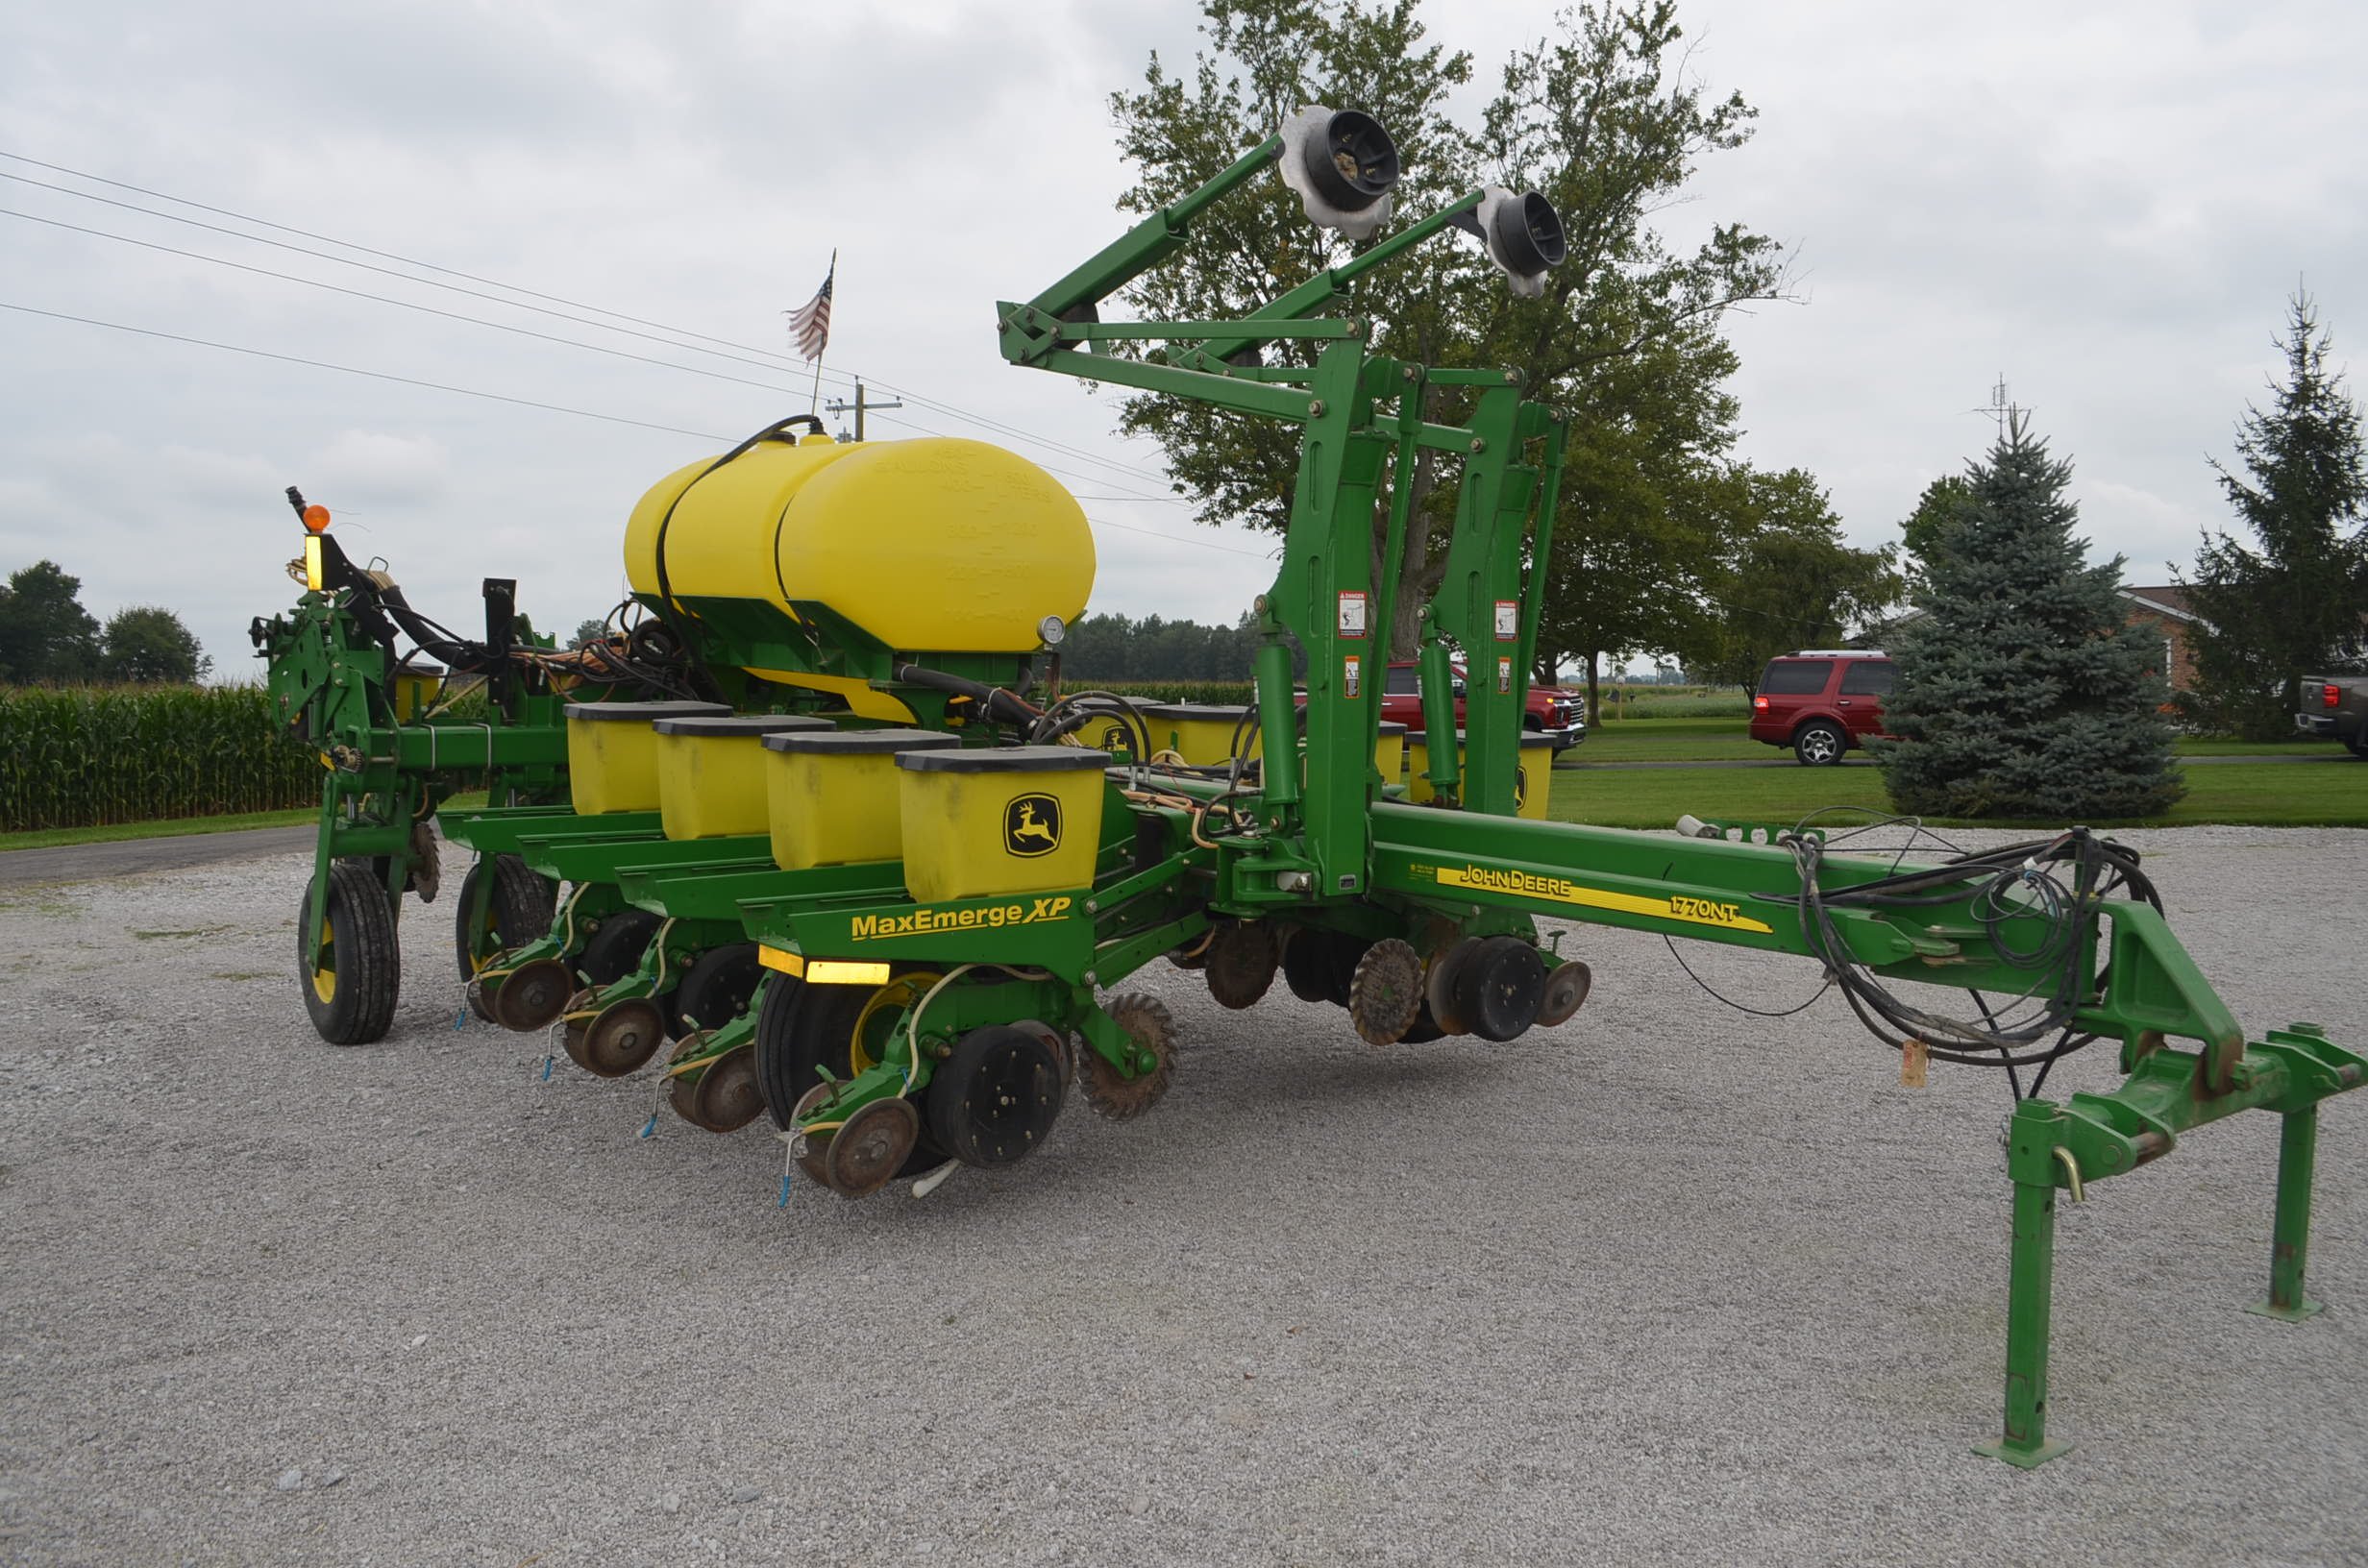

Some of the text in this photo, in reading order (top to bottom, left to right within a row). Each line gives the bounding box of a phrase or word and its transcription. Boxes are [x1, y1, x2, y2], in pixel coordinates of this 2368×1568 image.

[873, 459, 970, 476] GALLONS
[1461, 864, 1509, 888] JOHN
[1510, 870, 1572, 897] DEERE
[851, 896, 1072, 938] MaxEmerge XP
[1670, 895, 1739, 922] 1770NT
